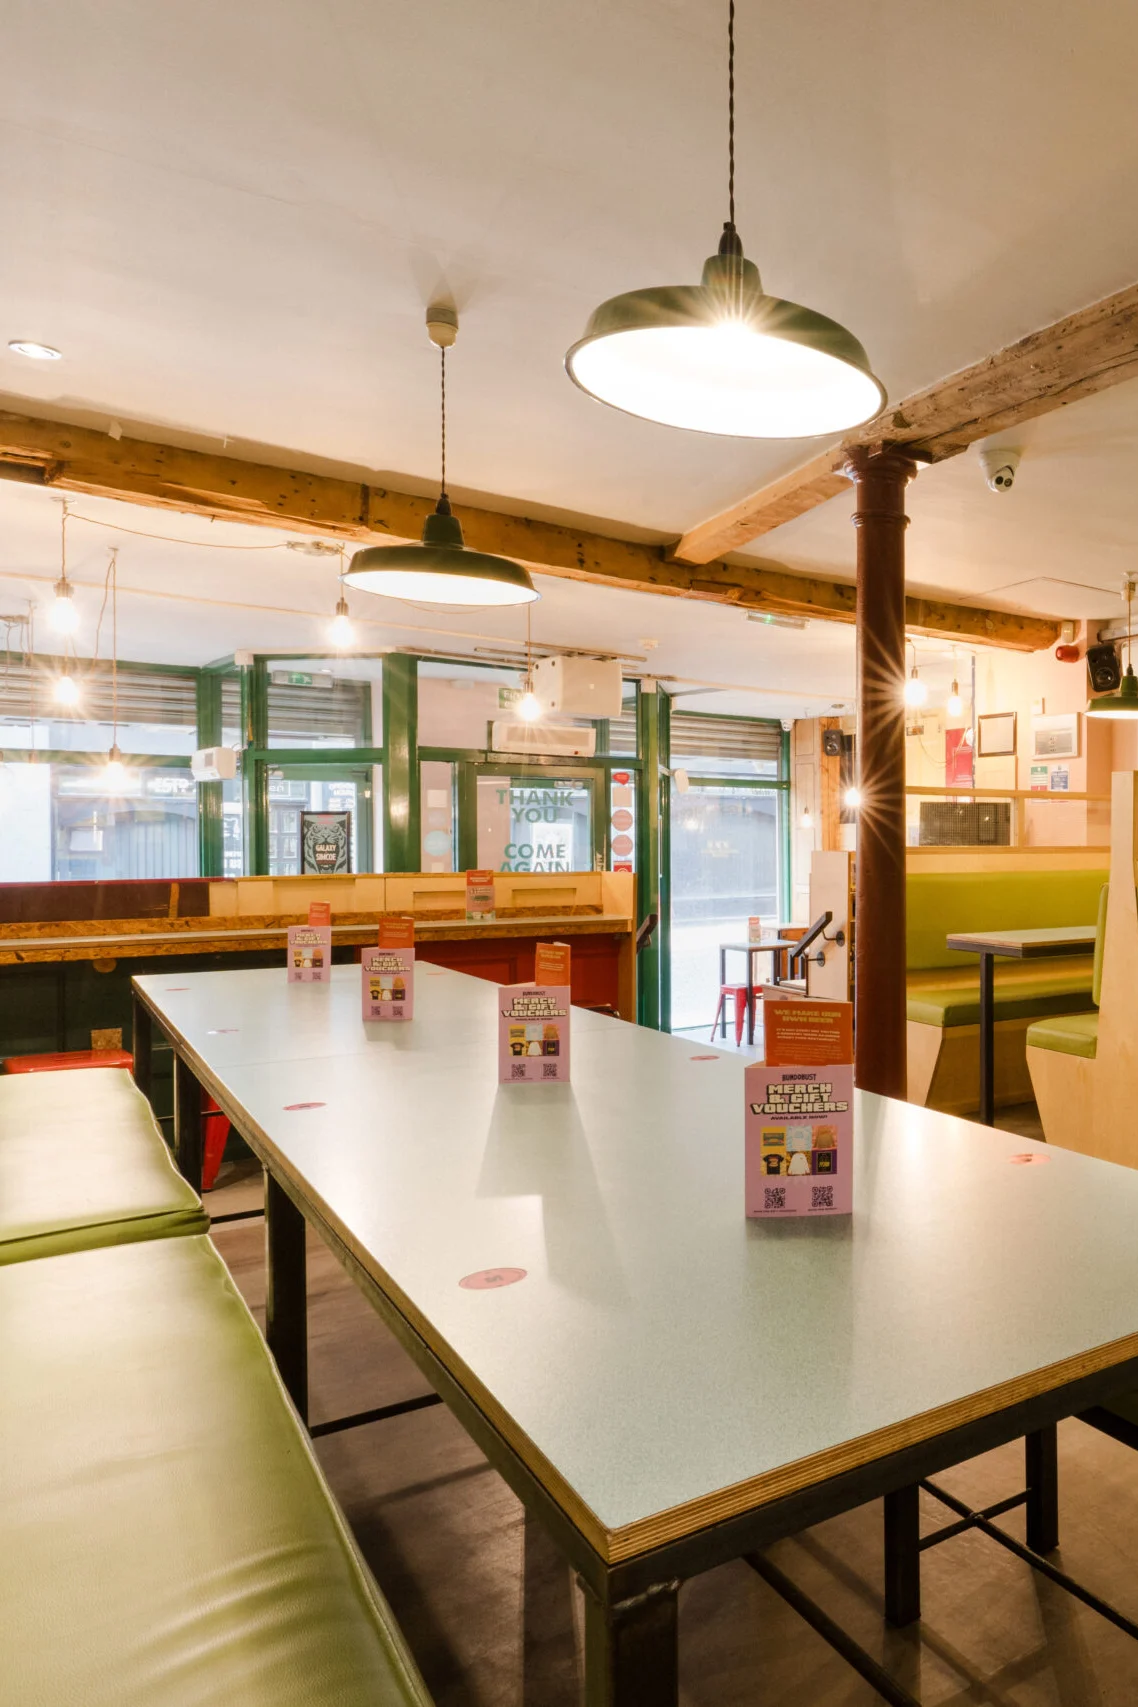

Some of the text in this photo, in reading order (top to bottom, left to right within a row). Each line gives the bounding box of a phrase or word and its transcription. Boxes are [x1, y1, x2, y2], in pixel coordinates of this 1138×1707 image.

[495, 789, 574, 806] THANK
[511, 807, 558, 823] YOU
[315, 853, 337, 861] SIMCOE
[503, 843, 566, 860] COME
[499, 861, 570, 872] AGAIN
[512, 997, 557, 1005] MERCH
[528, 1003, 556, 1011] GIFT
[502, 1009, 568, 1018] VOUCHERS
[781, 1073, 817, 1081] BUNDOBUST
[767, 1083, 833, 1095] MERCH
[768, 1092, 831, 1103] & GIFT
[752, 1102, 849, 1115] VOUCHERS
